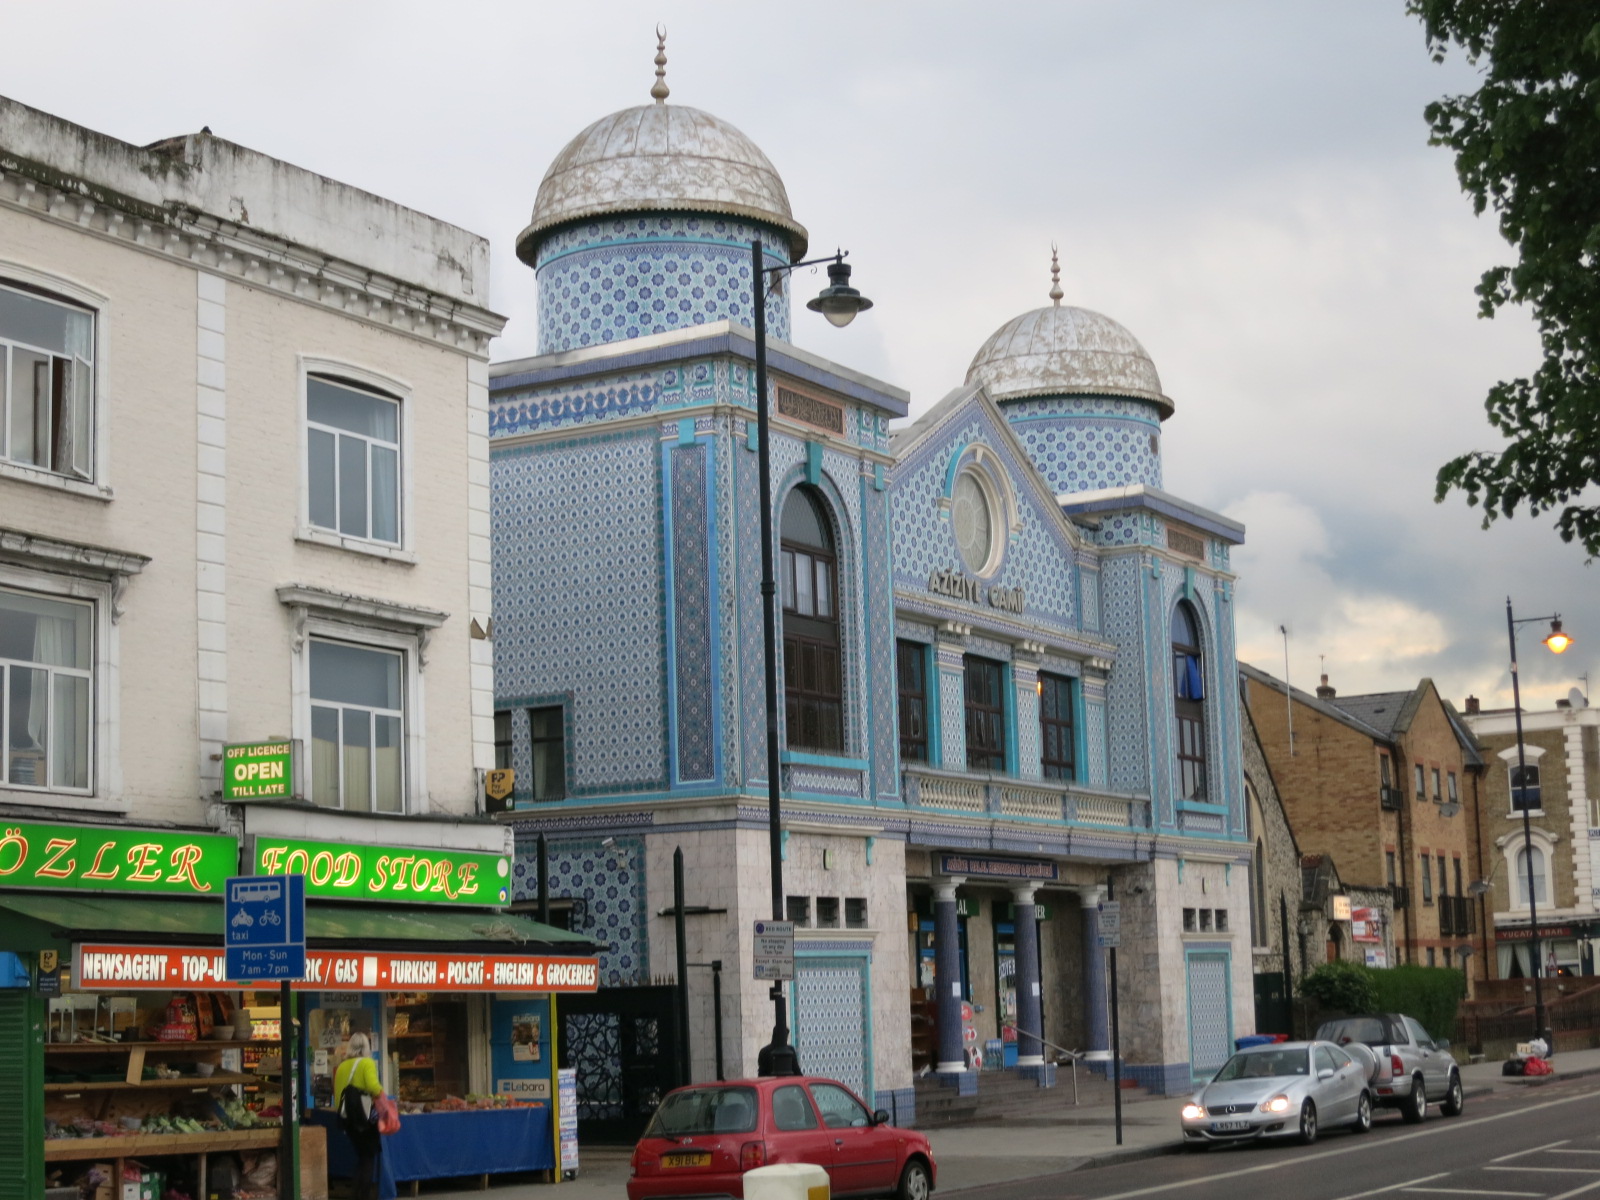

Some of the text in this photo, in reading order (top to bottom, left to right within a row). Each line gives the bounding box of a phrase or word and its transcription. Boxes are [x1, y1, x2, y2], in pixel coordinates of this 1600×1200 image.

[227, 743, 290, 759] OFF LICENCE
[234, 760, 284, 781] OPEN
[232, 783, 285, 797] TILL LATE
[262, 846, 479, 900] FOOD STORE
[231, 930, 249, 940] taxi
[242, 950, 263, 960] Mon
[269, 949, 288, 960] Sun
[83, 952, 168, 981] NEWSAGENT
[334, 958, 358, 983] GAS
[390, 960, 437, 984] TURKISH
[493, 962, 534, 985] ENGLISH
[536, 964, 544, 985] &
[546, 964, 596, 986] GROCERIES
[511, 1082, 545, 1092] Lebara
